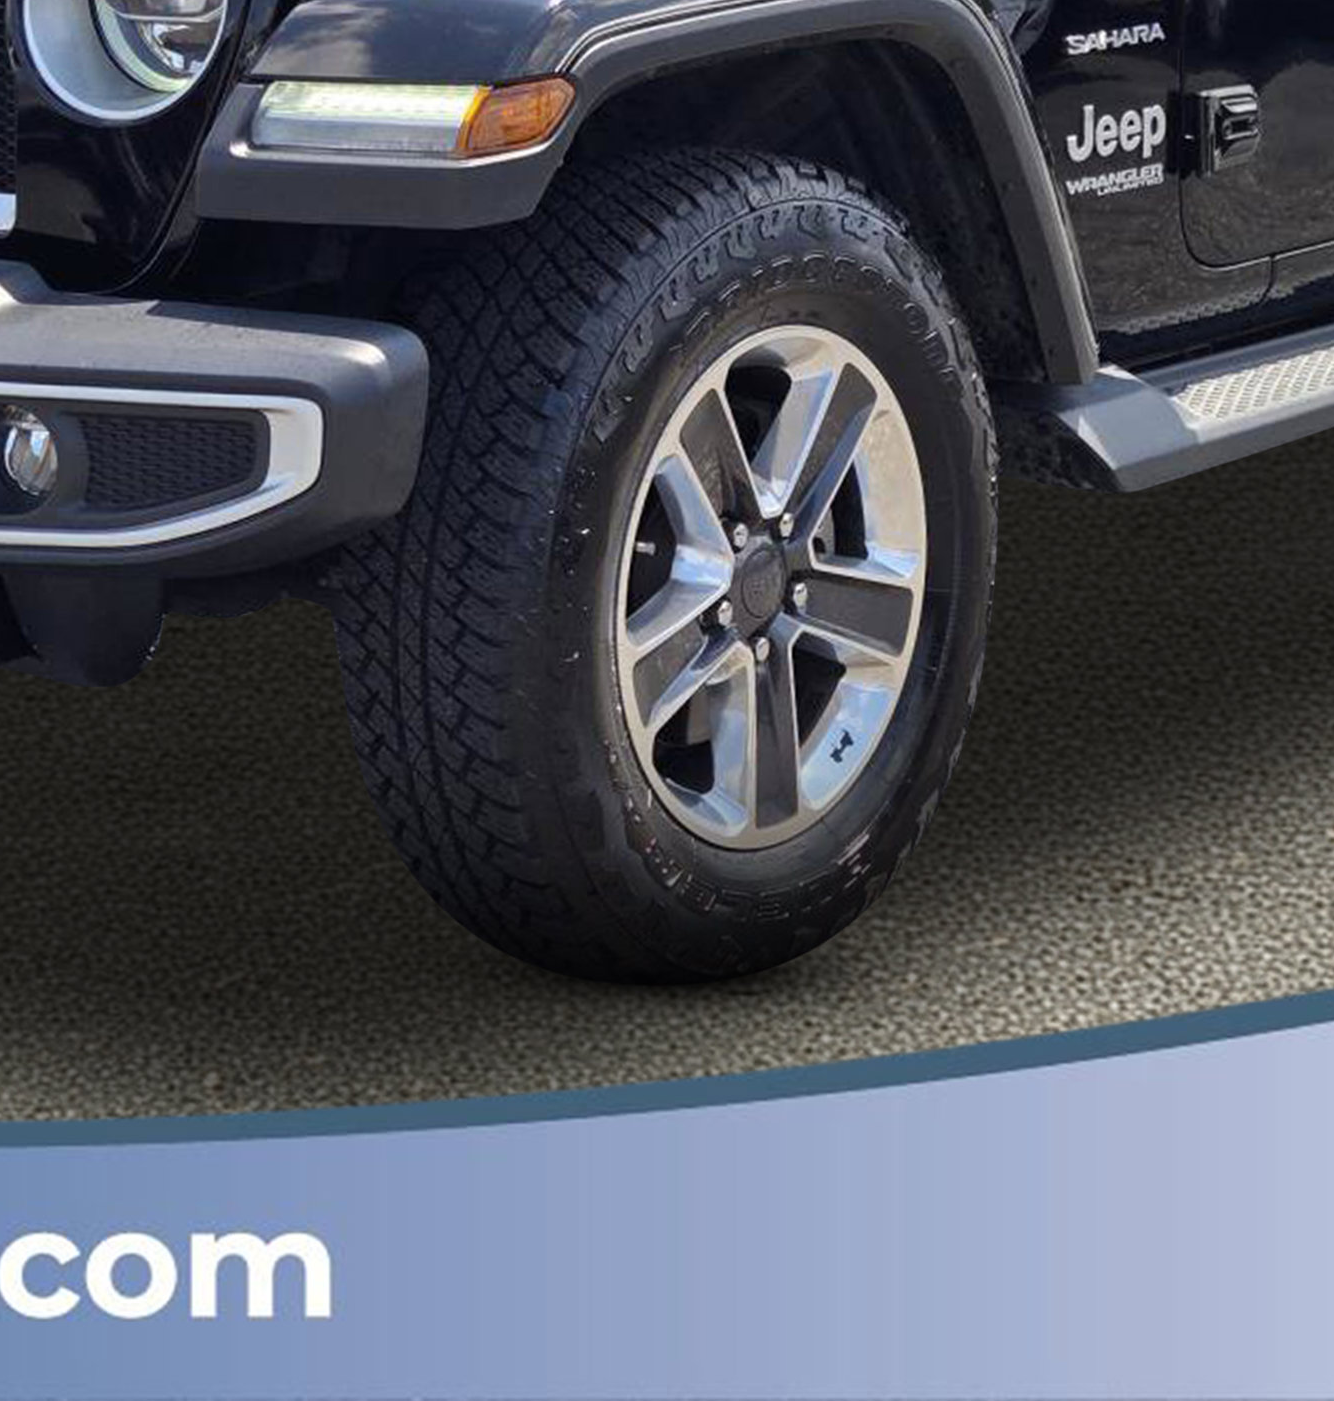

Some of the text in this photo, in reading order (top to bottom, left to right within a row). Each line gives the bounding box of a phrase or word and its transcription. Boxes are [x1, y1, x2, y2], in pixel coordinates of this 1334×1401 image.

[1066, 22, 1166, 56] SAHARA
[1066, 103, 1167, 163] Jeep
[1065, 163, 1165, 196] WRANGLER
